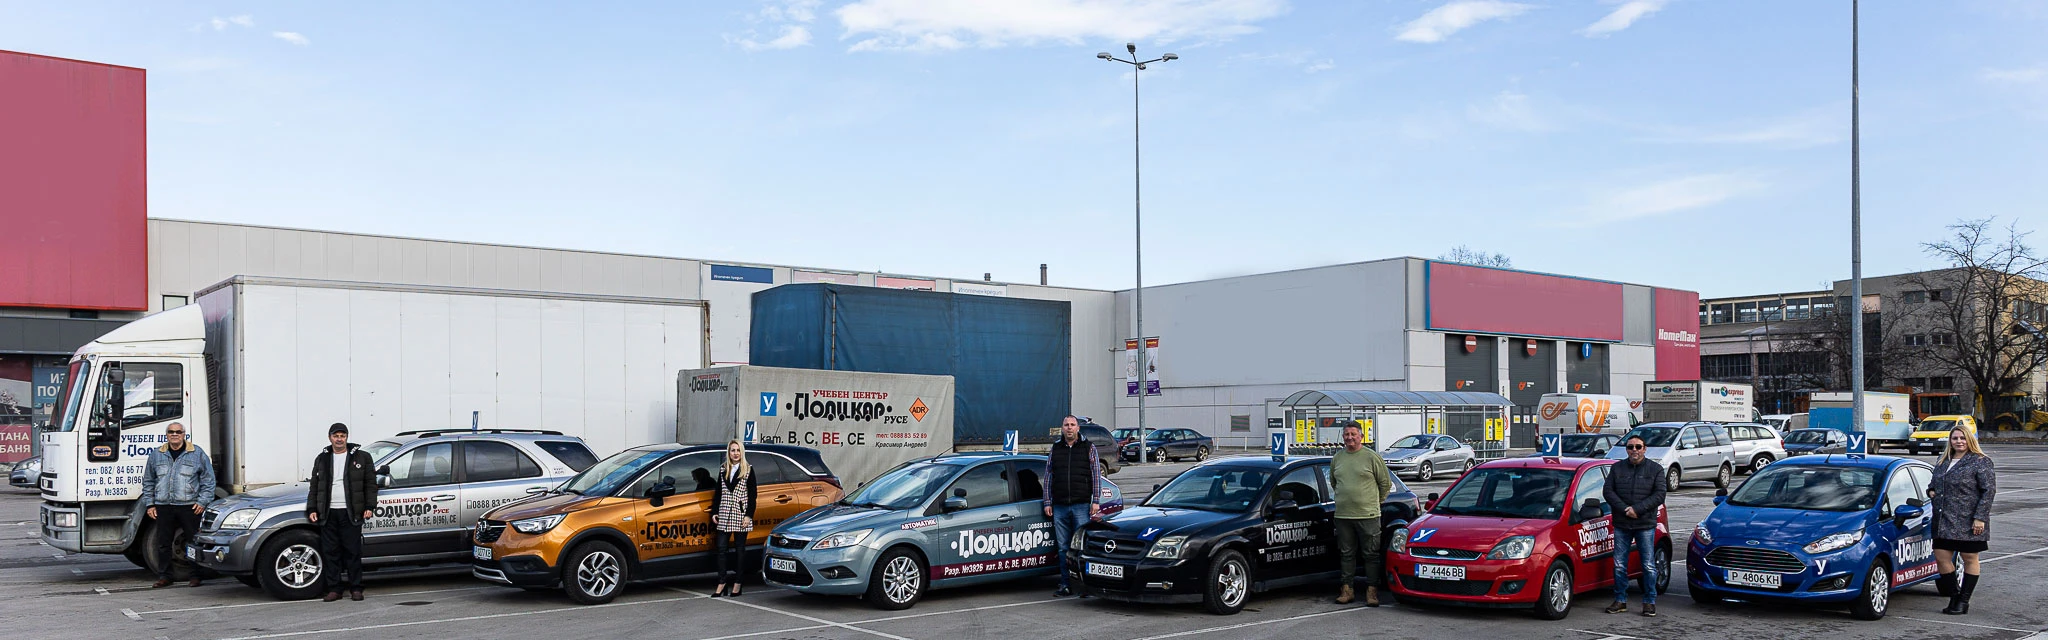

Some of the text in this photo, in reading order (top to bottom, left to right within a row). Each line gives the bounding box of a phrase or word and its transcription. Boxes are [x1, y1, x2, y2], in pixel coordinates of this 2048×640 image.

[1658, 328, 1696, 342] HomeMax
[813, 390, 888, 400] УЧЕБЕН ЦЕНТЪР
[884, 416, 908, 424] РУСЕ
[121, 434, 190, 443] УЧЕБЕН ЦЕР
[136, 465, 144, 474] 77
[363, 522, 374, 530] азр.
[902, 519, 936, 530] АВТОМАТИК
[1431, 566, 1450, 576] 4446
[1742, 573, 1765, 584] 4806
